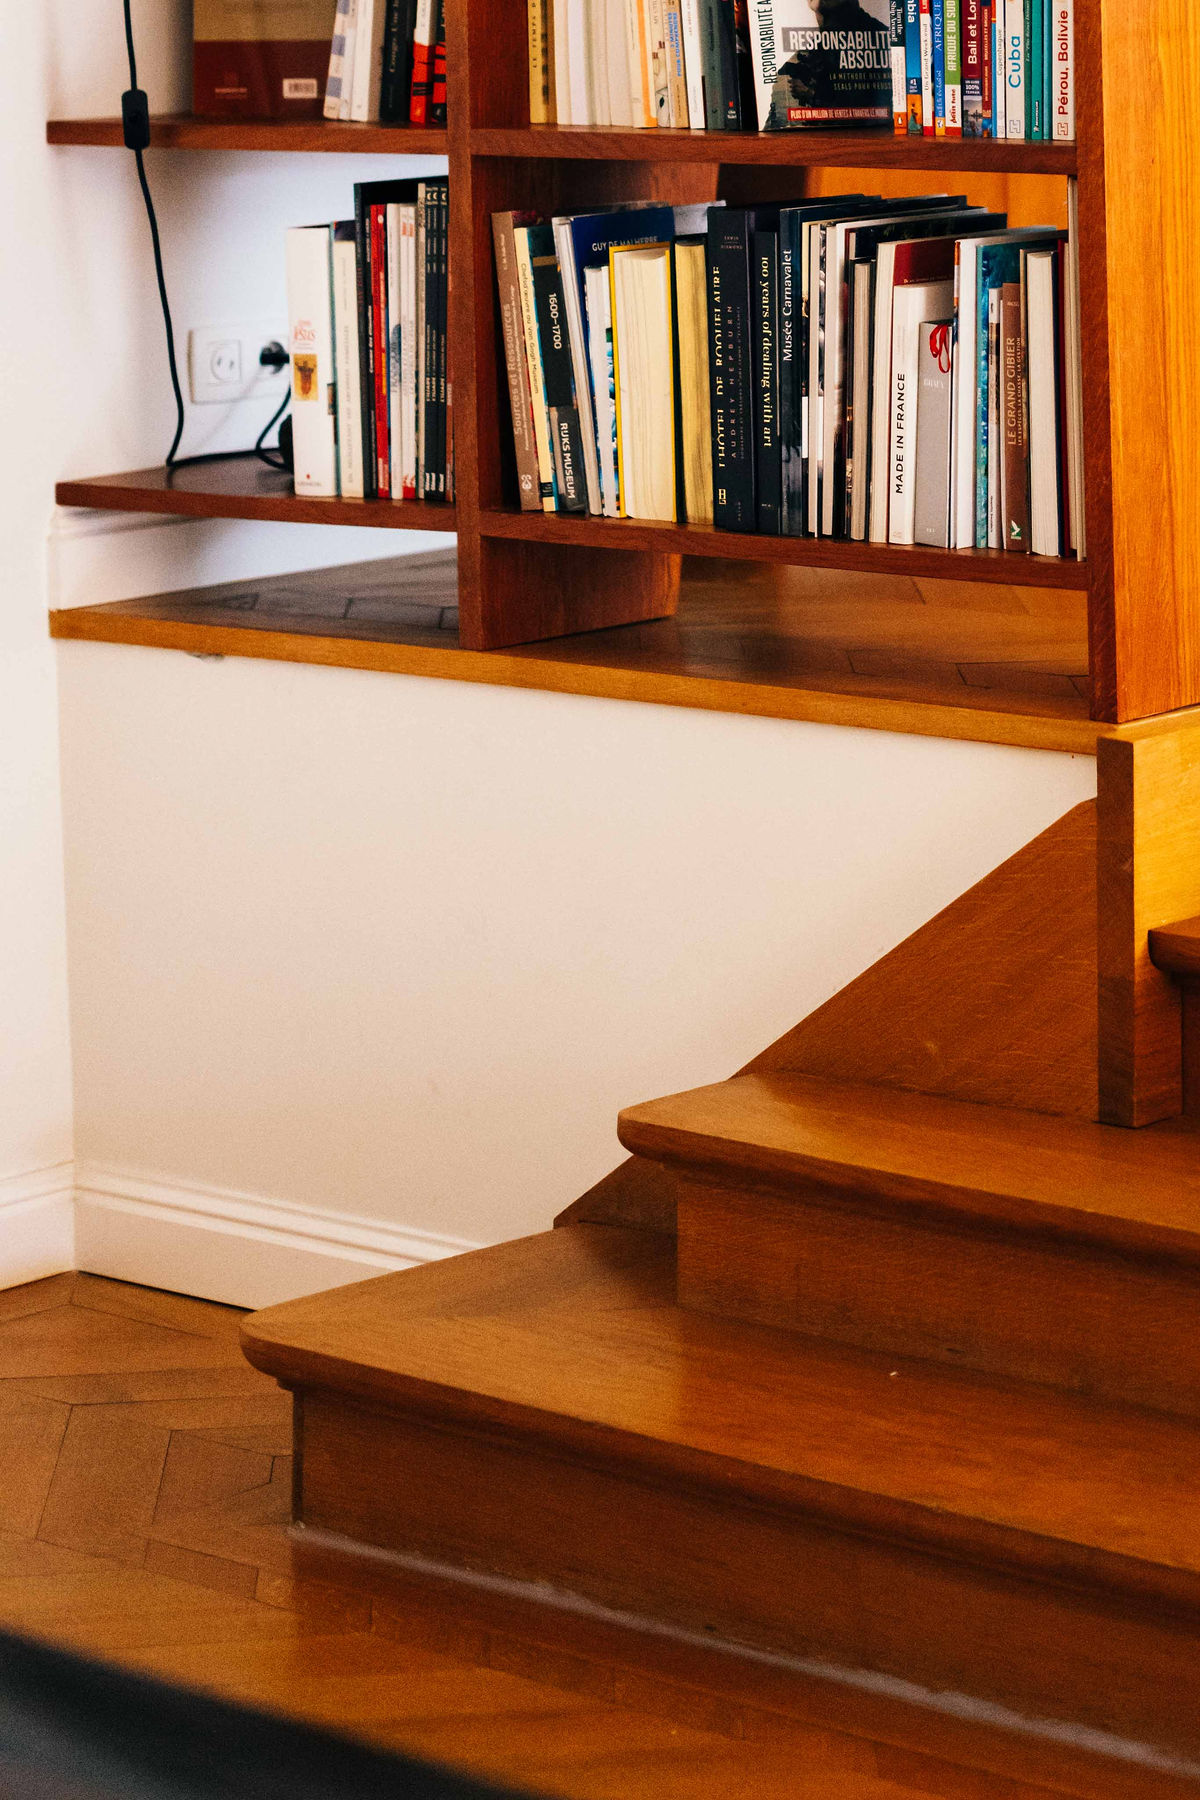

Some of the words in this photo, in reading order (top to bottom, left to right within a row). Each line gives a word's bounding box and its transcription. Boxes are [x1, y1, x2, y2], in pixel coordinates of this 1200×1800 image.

[934, 1, 943, 52] AFRIQUE
[946, 0, 956, 18] SUD
[947, 20, 956, 33] DU
[754, 7, 778, 85] RESPONSABILITÉ
[968, 23, 977, 37] et
[1057, 10, 1068, 62] Bolivie
[947, 34, 957, 71] AFRIQUE
[967, 40, 977, 64] Bali
[1008, 35, 1021, 88] Cuba
[1057, 67, 1070, 115] Pérou,
[592, 242, 607, 252] GUY
[761, 256, 770, 278] 100
[781, 249, 792, 316] Carnavalet
[759, 281, 770, 318] years
[502, 303, 517, 371] Ressources
[726, 305, 735, 385] HEPBURN
[762, 321, 773, 337] of
[782, 320, 793, 361] Musée
[528, 342, 537, 362] Gogh
[761, 337, 773, 388] dealing
[1006, 337, 1015, 378] GIBIER
[509, 373, 518, 385] et
[531, 363, 539, 394] Museum
[511, 388, 523, 435] Sources
[762, 392, 773, 423] with
[896, 373, 905, 430] FRANCE
[1006, 382, 1016, 427] GRAND
[762, 427, 772, 448] art
[895, 435, 904, 449] IN
[1007, 431, 1017, 445] LE
[563, 452, 576, 499] MUSEUM
[895, 454, 904, 494] MADE
